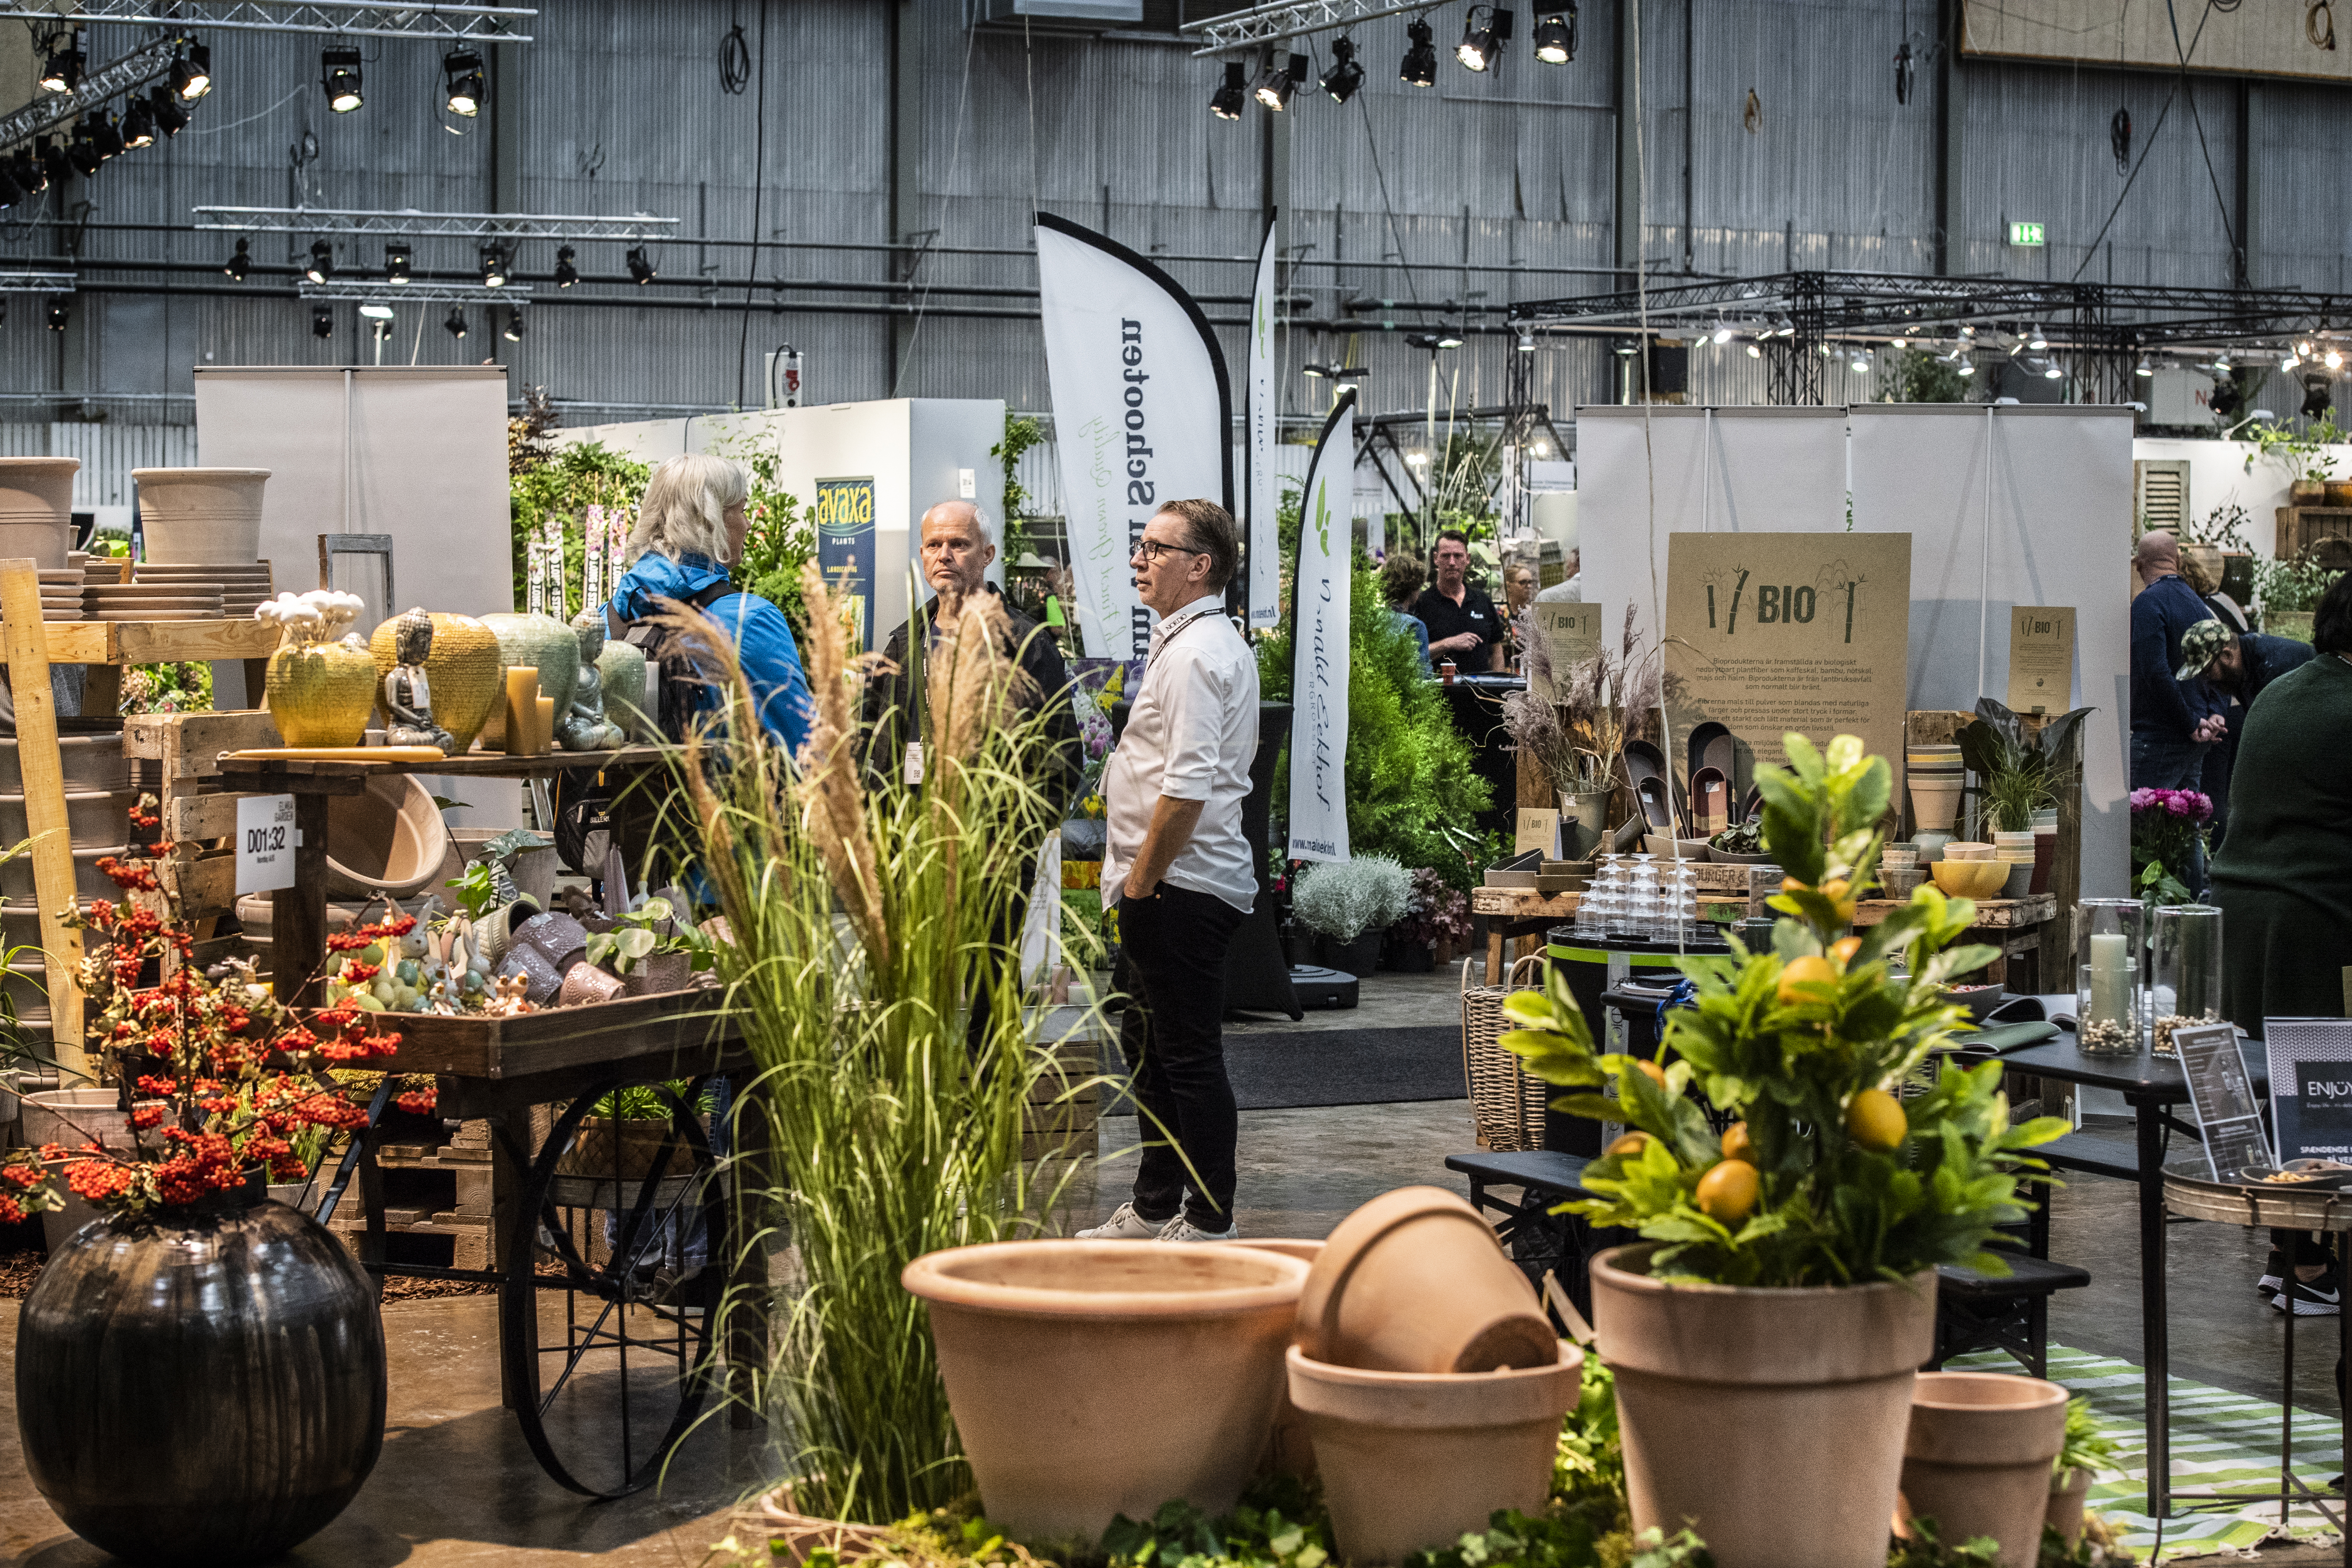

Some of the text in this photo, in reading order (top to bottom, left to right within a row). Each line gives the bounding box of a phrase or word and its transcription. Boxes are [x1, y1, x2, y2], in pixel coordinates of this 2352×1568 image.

[819, 487, 871, 524] avaxa
[588, 561, 599, 583] LONG
[531, 585, 542, 607] LONG
[1758, 585, 1816, 623] BIO
[1558, 617, 1575, 629] BIO
[2035, 621, 2050, 634] BIO
[1316, 693, 1331, 812] Eekhof
[1531, 820, 1541, 828] BIO
[248, 825, 286, 853] D01:32
